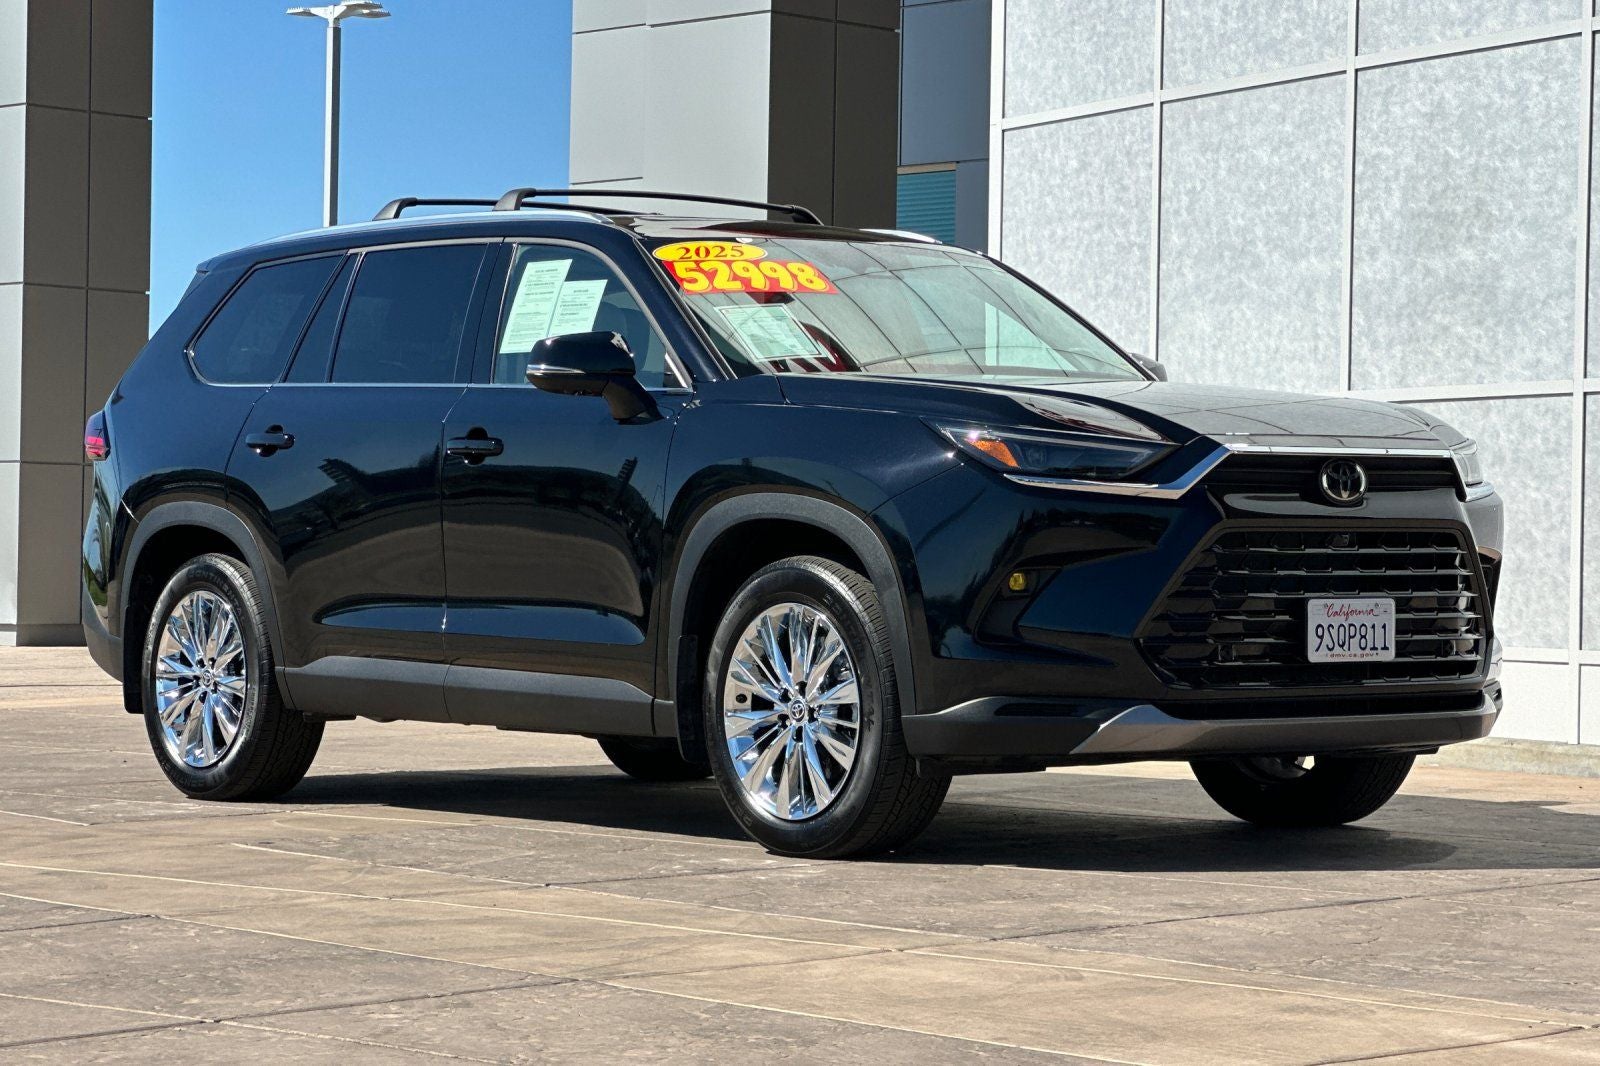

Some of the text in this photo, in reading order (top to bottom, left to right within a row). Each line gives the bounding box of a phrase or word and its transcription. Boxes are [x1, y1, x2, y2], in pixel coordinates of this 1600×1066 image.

[676, 245, 744, 260] 2025
[673, 261, 829, 292] 52998
[1326, 603, 1379, 621] California
[1314, 622, 1390, 653] 9SQP811
